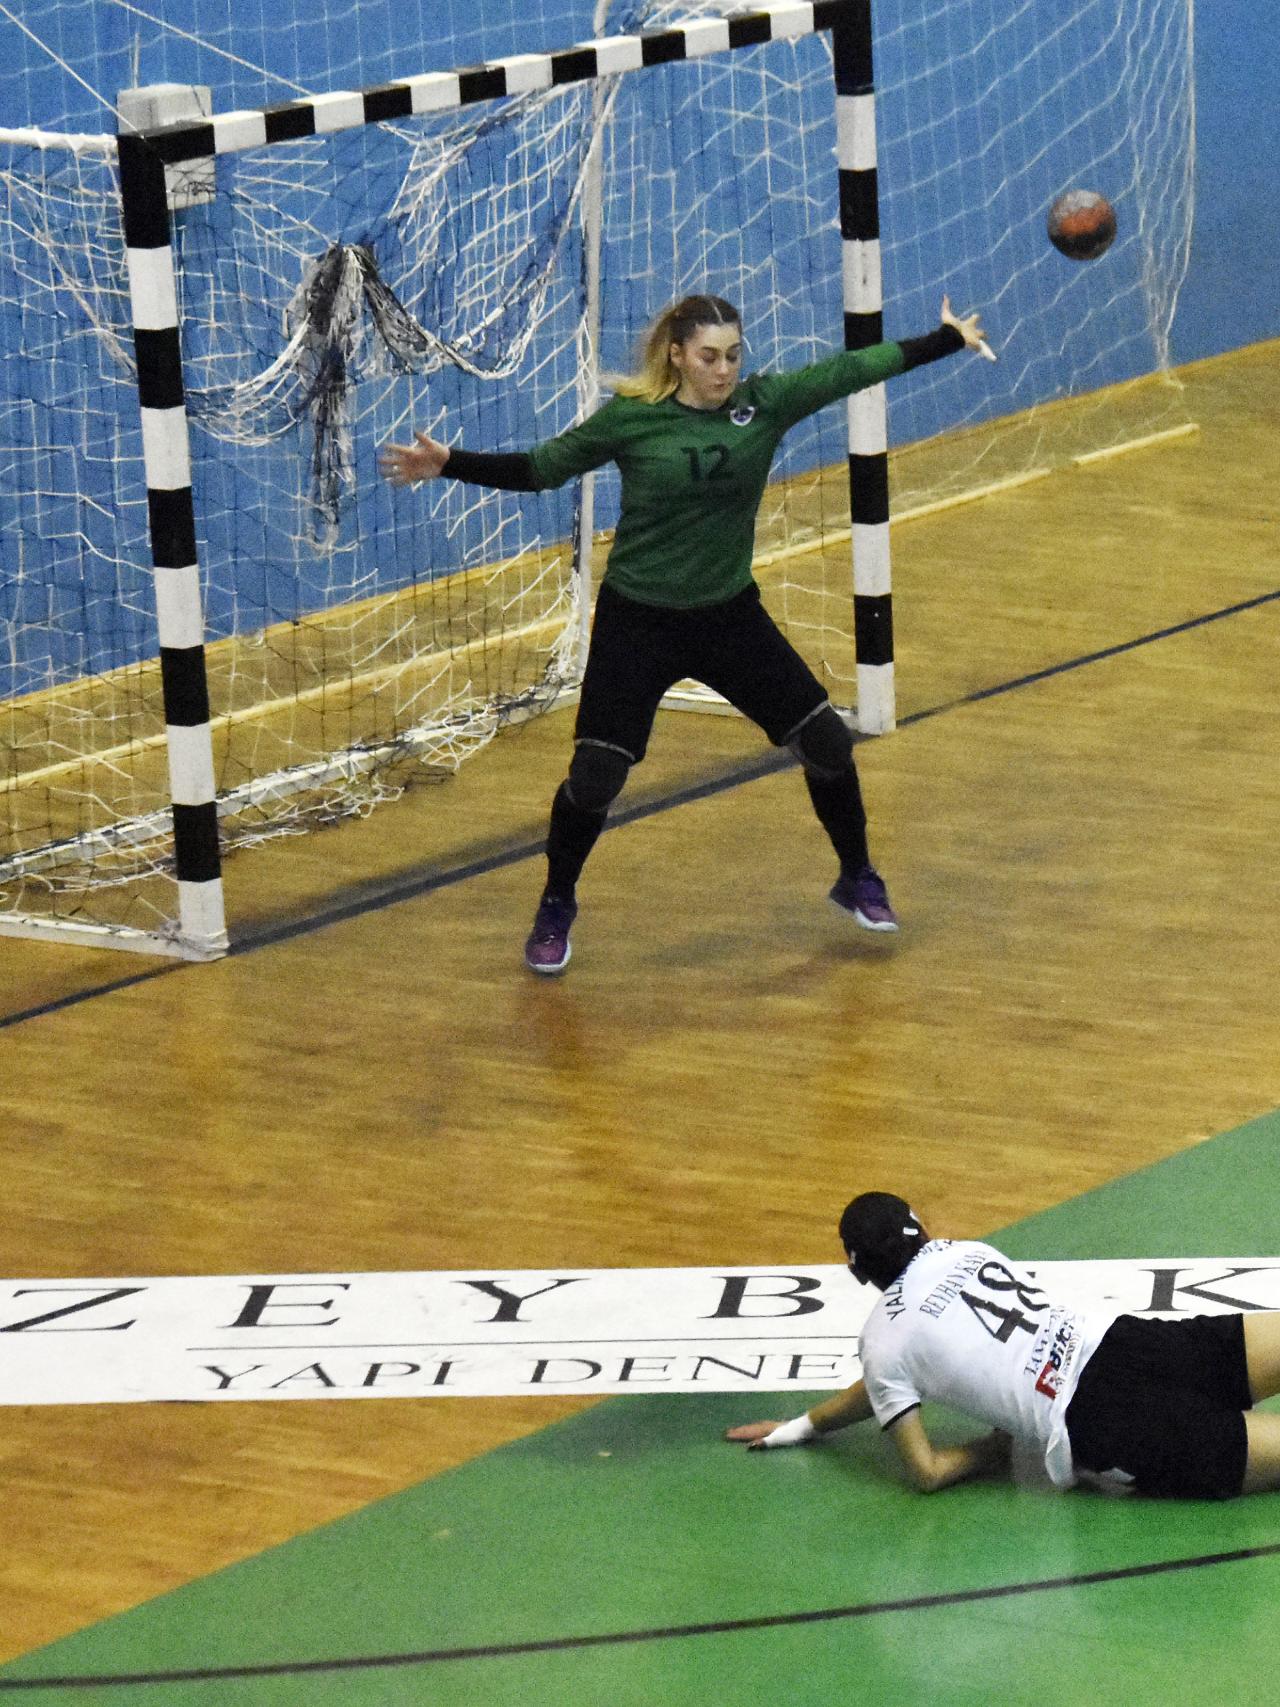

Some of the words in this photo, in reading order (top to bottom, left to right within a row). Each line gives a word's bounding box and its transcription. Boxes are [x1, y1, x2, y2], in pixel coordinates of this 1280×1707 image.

[681, 443, 734, 482] 12
[958, 1261, 1050, 1344] 48
[200, 1360, 466, 1390] YAPI
[520, 1353, 863, 1385] DENE
